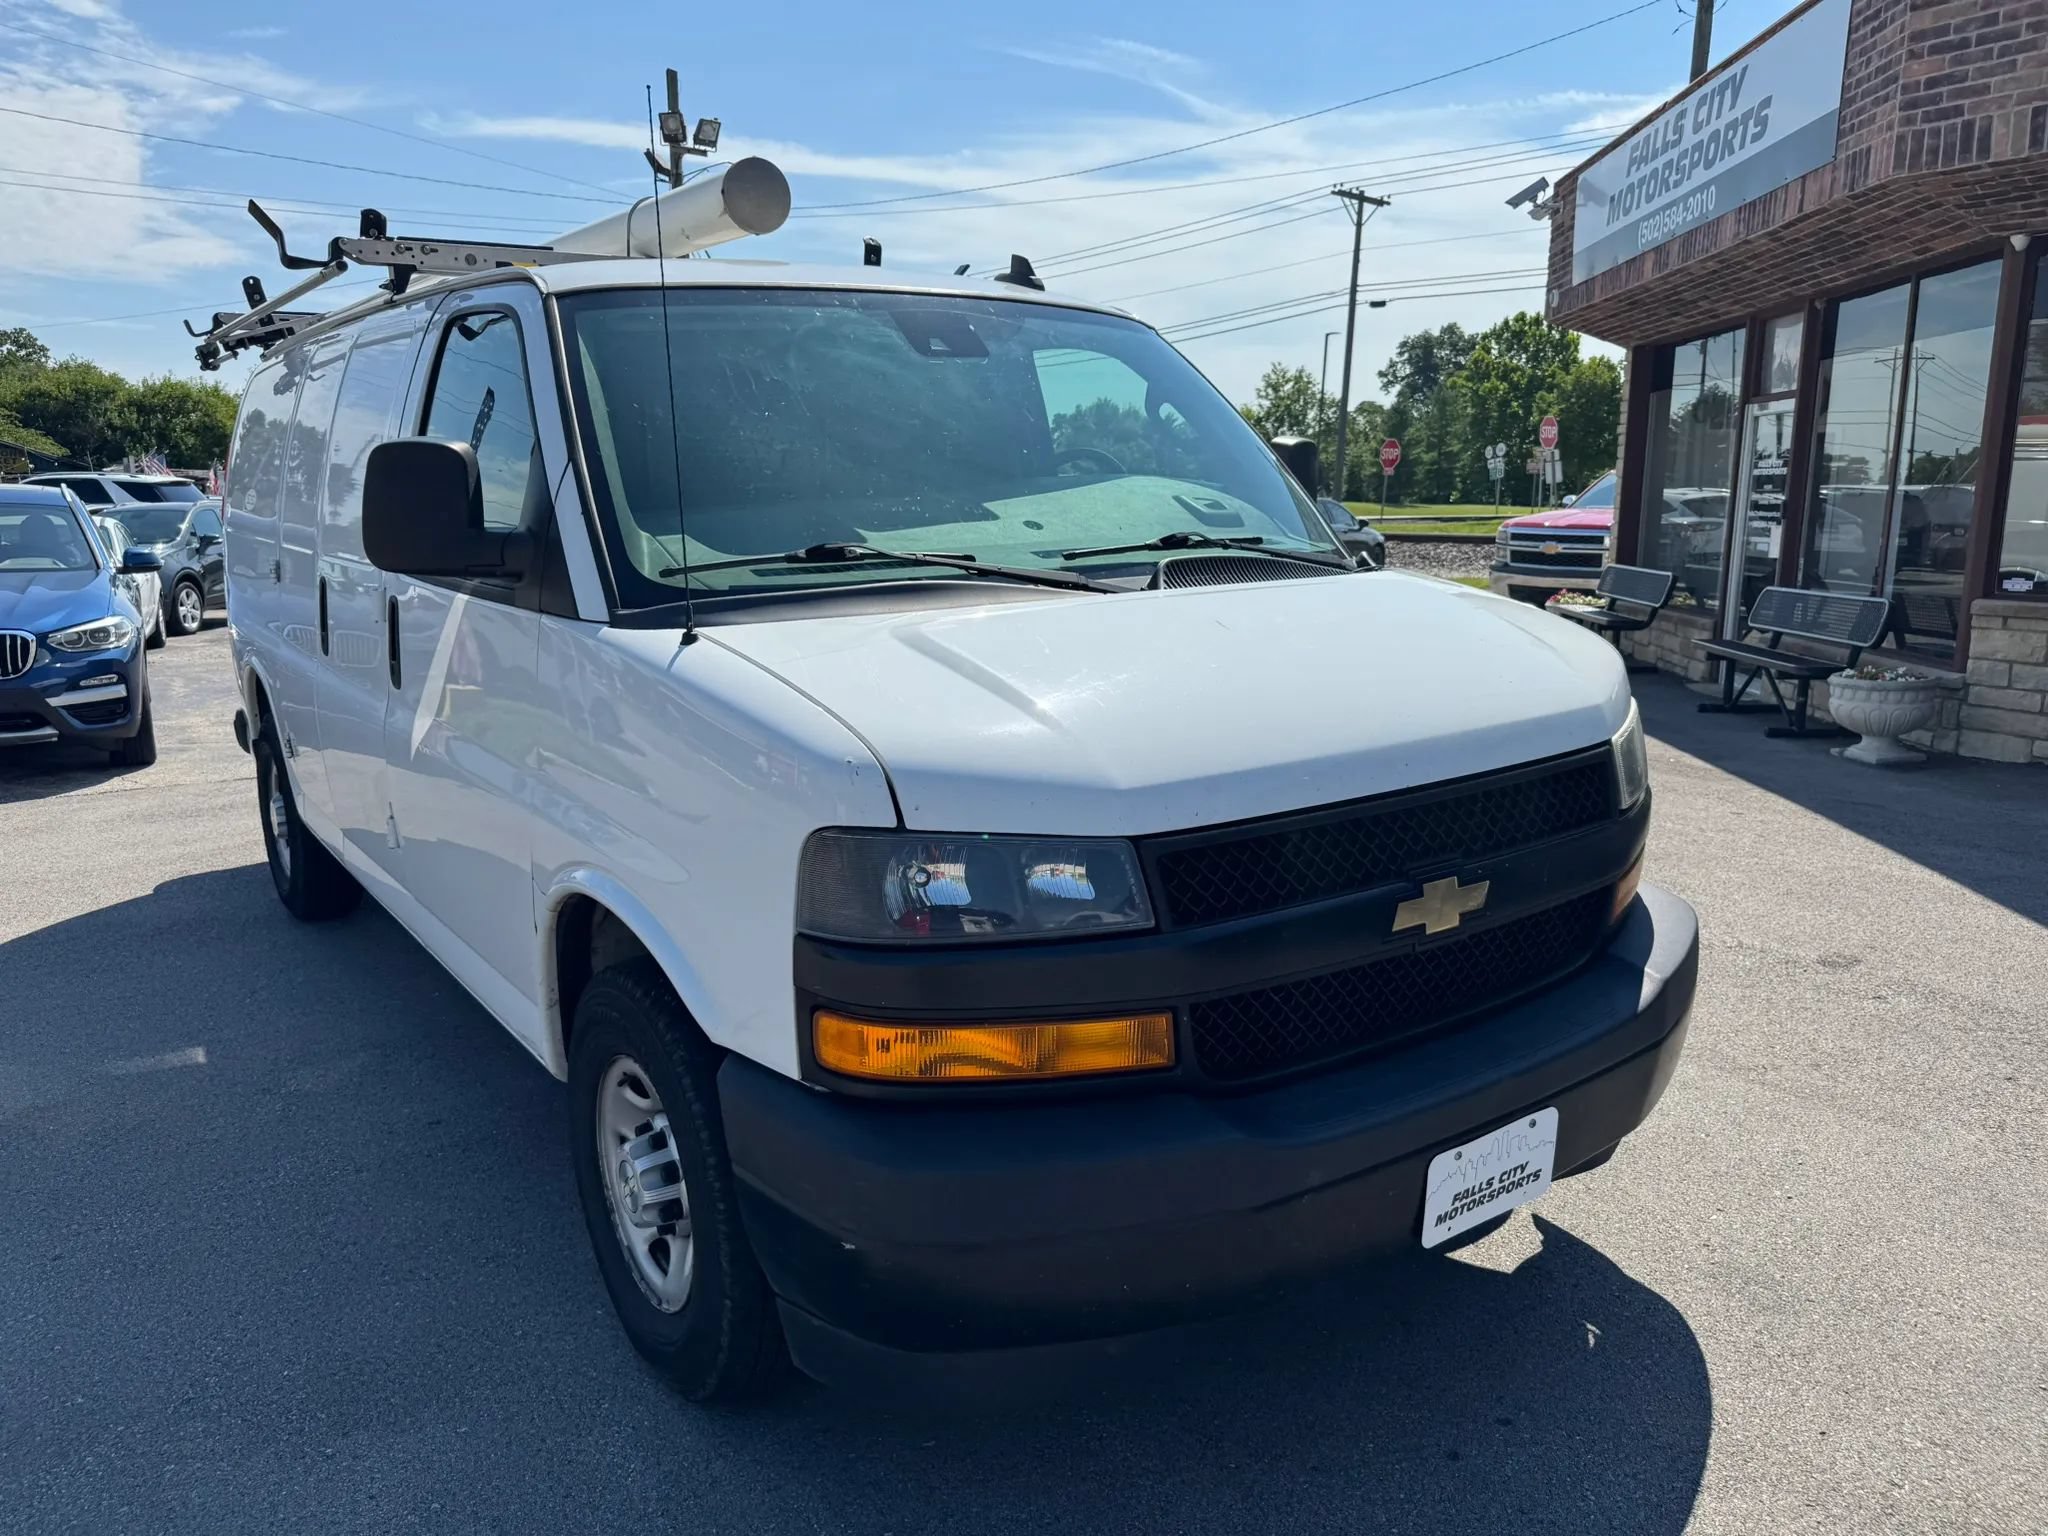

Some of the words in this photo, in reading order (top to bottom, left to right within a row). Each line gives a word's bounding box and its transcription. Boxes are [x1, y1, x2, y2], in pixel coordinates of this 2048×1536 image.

[1626, 107, 1688, 178] FALLS
[1692, 64, 1749, 135] CITY
[1606, 95, 1773, 226] MOTORSPORTS
[1638, 186, 1716, 249] (502)584-2010
[1381, 448, 1399, 460] STOP
[1541, 426, 1556, 438] STOP
[1434, 1169, 1542, 1227] MOTORSPORTS
[1451, 1176, 1495, 1206] FALLS
[1498, 1161, 1529, 1184] CITY
